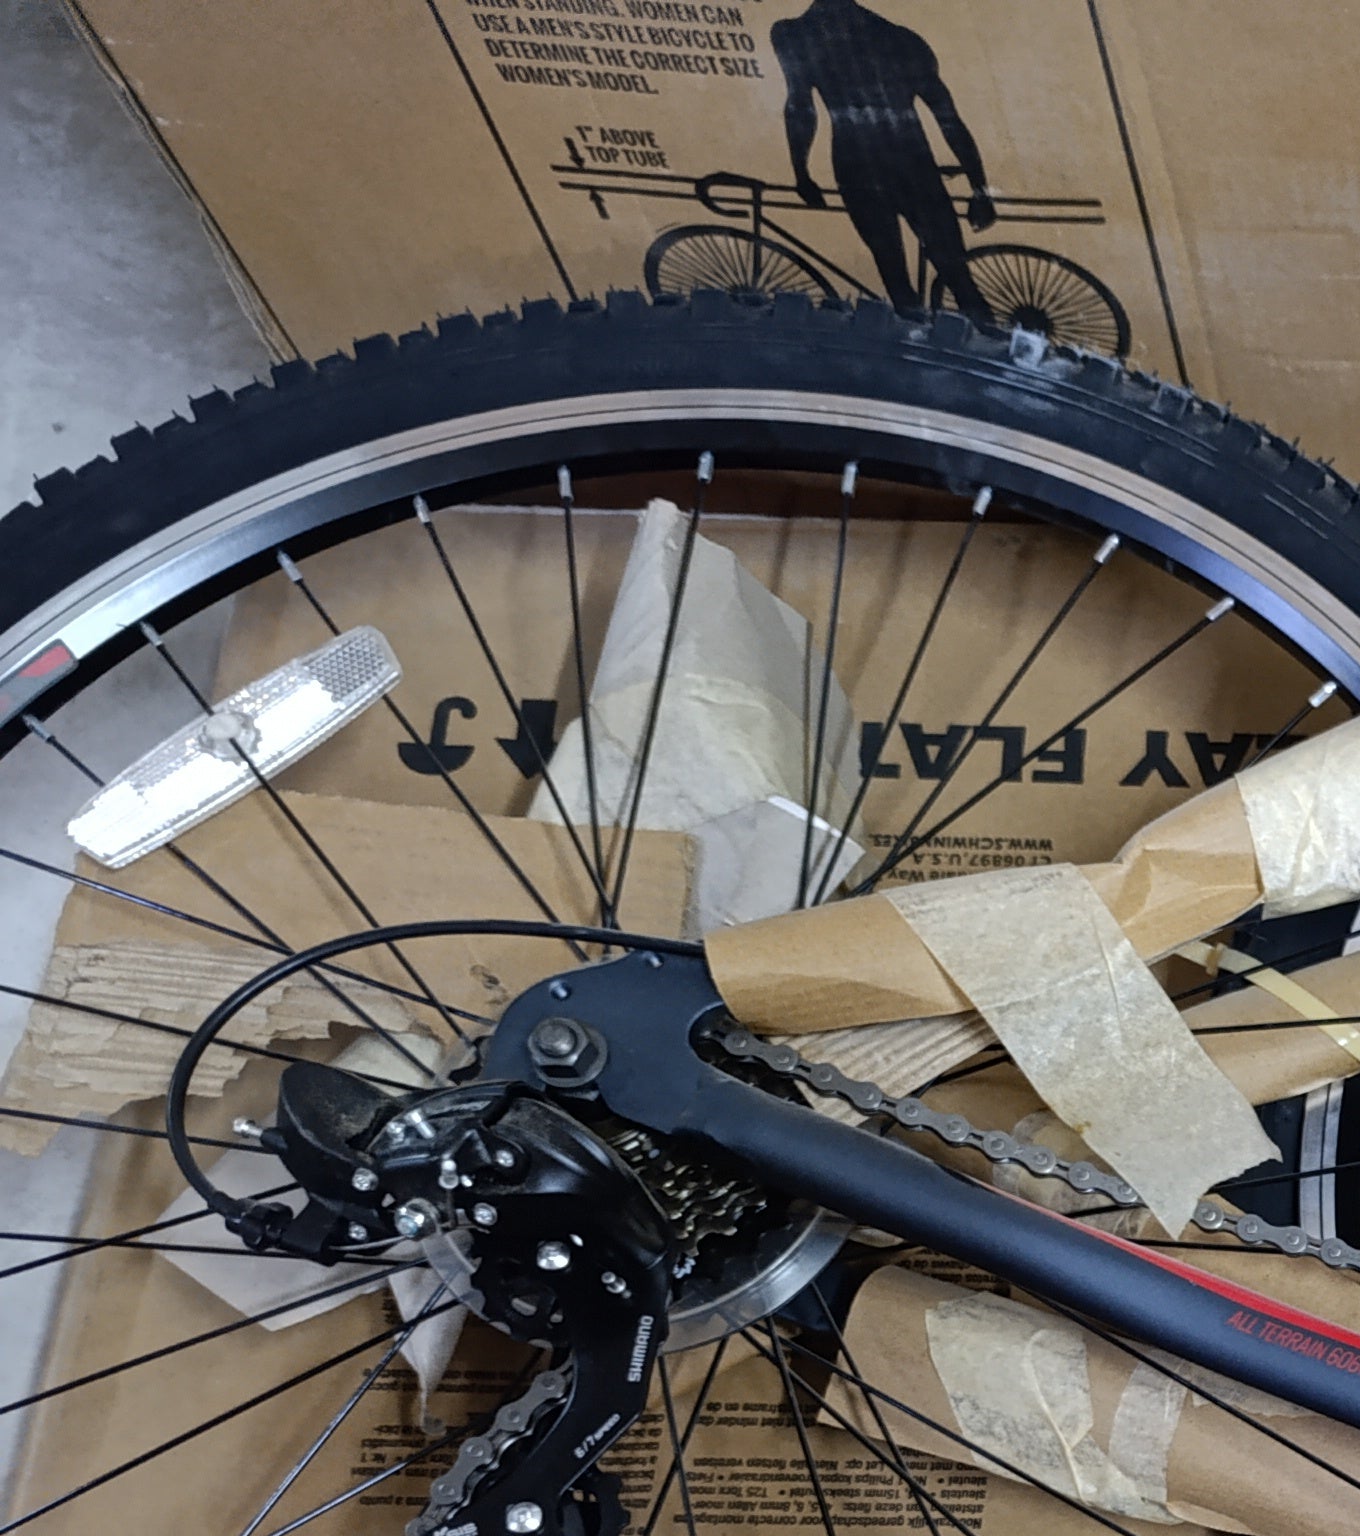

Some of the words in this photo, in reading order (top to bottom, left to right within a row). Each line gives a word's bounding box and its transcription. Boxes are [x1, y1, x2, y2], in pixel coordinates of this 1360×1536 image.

[627, 1, 699, 24] WOMEN
[702, 5, 745, 28] CAN
[472, 13, 516, 36] USE
[590, 25, 648, 45] STYLE
[649, 29, 729, 50] BICYCLE
[731, 33, 756, 53] TO
[484, 38, 591, 66] DETERMINE
[592, 47, 628, 69] THE
[632, 51, 717, 76] CORRECT
[721, 57, 765, 79] SIZE
[494, 63, 590, 89] WOMEN'S
[590, 68, 660, 95] MODEL.
[599, 127, 659, 149] ABOVE
[586, 146, 626, 165] TOP
[626, 148, 672, 169] TUBE
[626, 1315, 654, 1383] SHIMANO
[1225, 1310, 1259, 1334] ALL
[1258, 1322, 1326, 1360] TERRAIN
